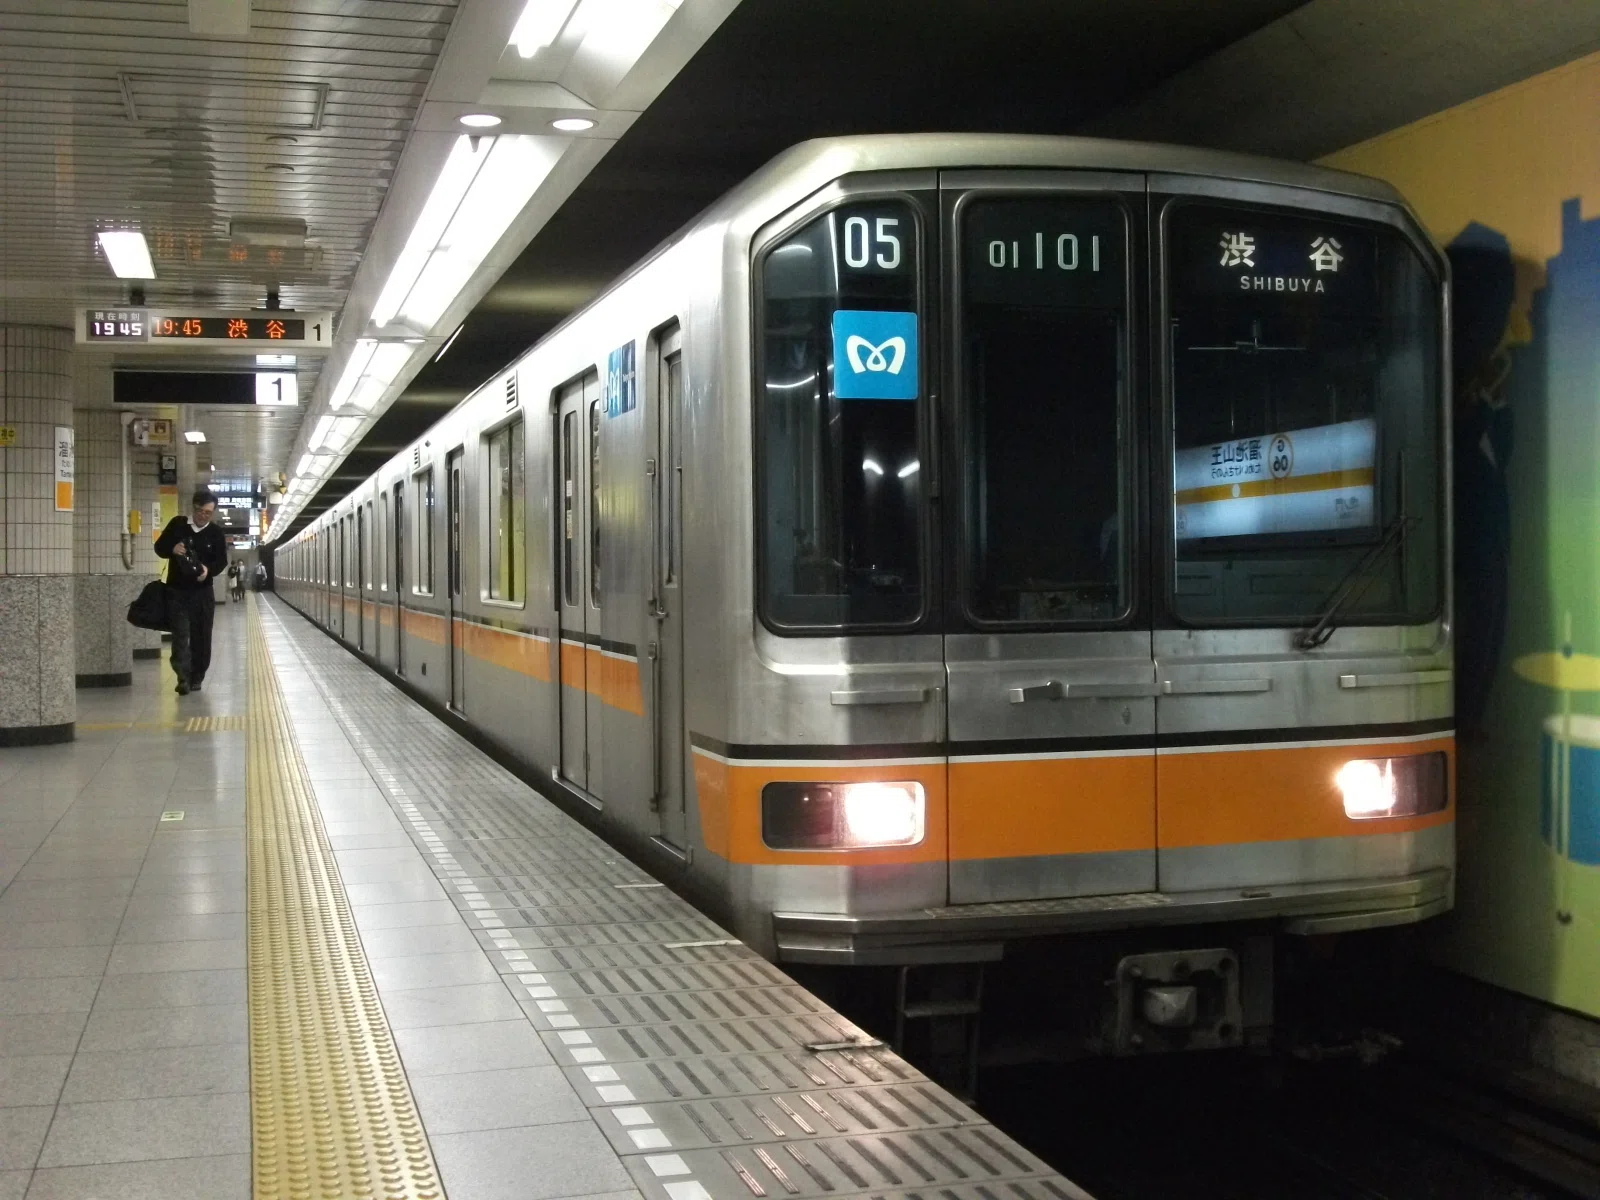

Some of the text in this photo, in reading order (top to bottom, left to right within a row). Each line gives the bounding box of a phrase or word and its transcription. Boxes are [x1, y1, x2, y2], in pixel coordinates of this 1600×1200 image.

[844, 216, 900, 269] 05
[1240, 275, 1325, 293] SHIBUYA
[94, 311, 140, 321] 現在時刻
[154, 319, 202, 335] 19:45
[312, 323, 321, 341] 1
[271, 377, 282, 401] 1
